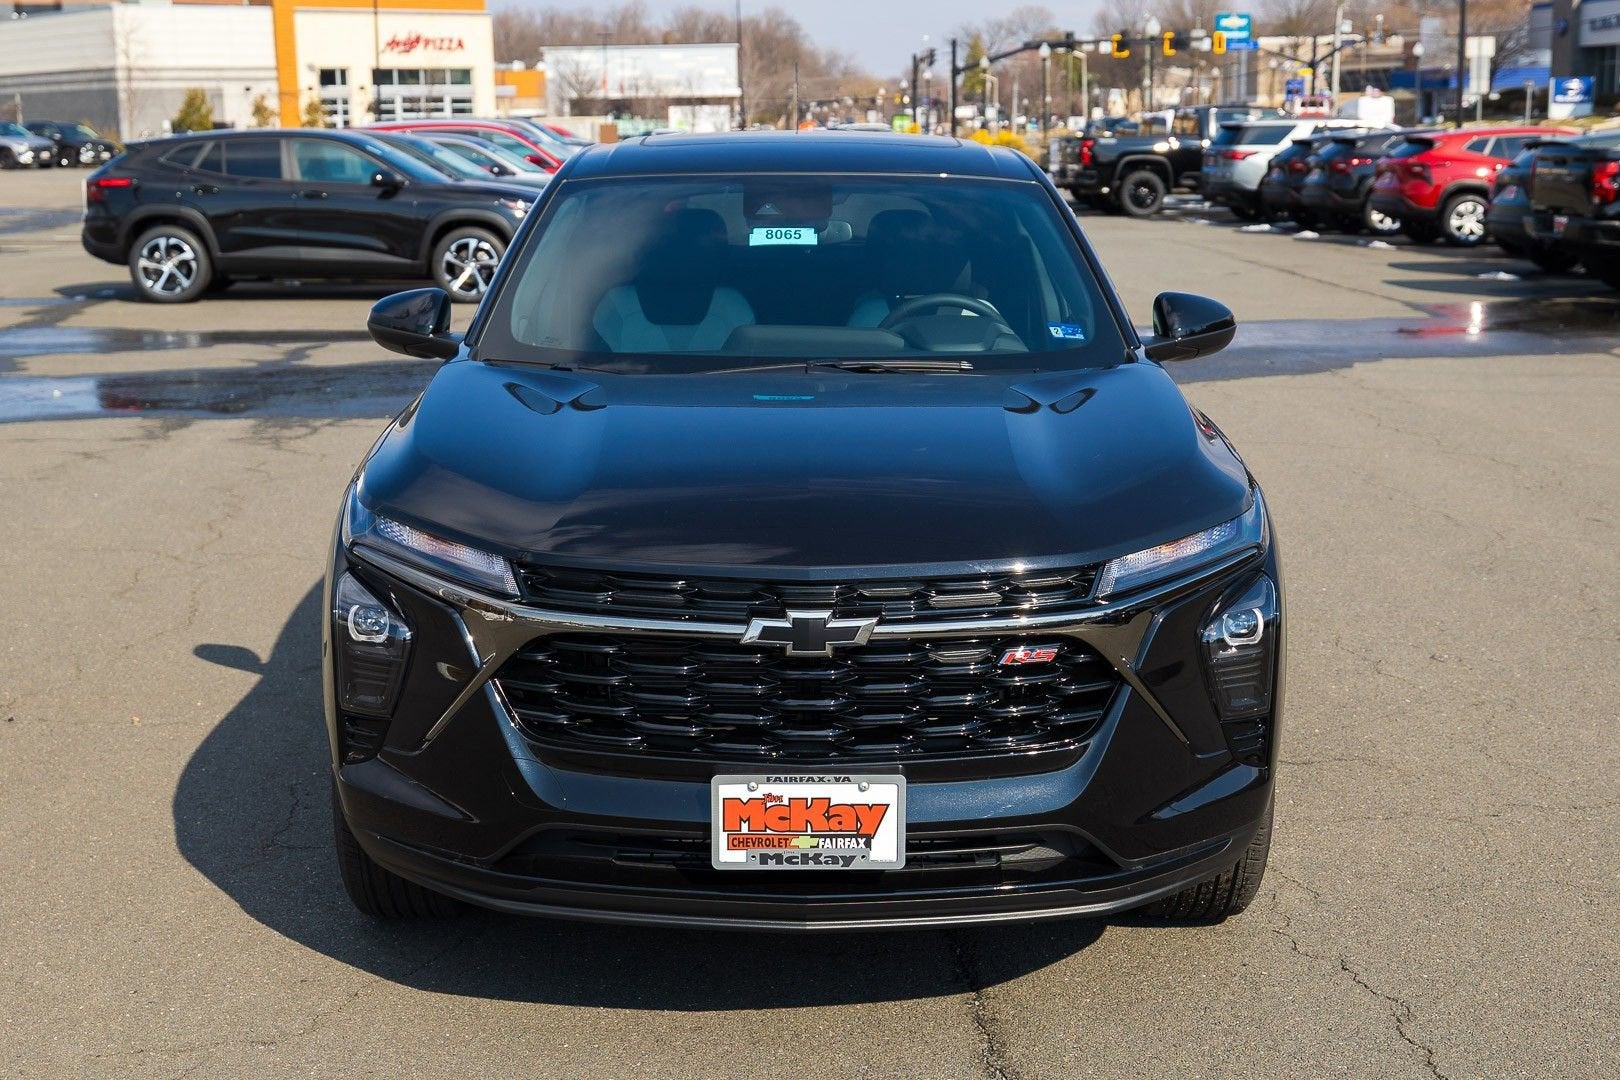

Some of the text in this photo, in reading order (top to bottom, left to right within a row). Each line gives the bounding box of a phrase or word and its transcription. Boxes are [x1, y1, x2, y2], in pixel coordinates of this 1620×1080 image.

[423, 38, 465, 51] PIZZA
[765, 229, 802, 240] 8065
[1000, 648, 1058, 665] RS
[723, 797, 890, 839] McKay
[731, 836, 867, 849] CHEVROLET FAIRFAX
[759, 852, 858, 868] McKay
